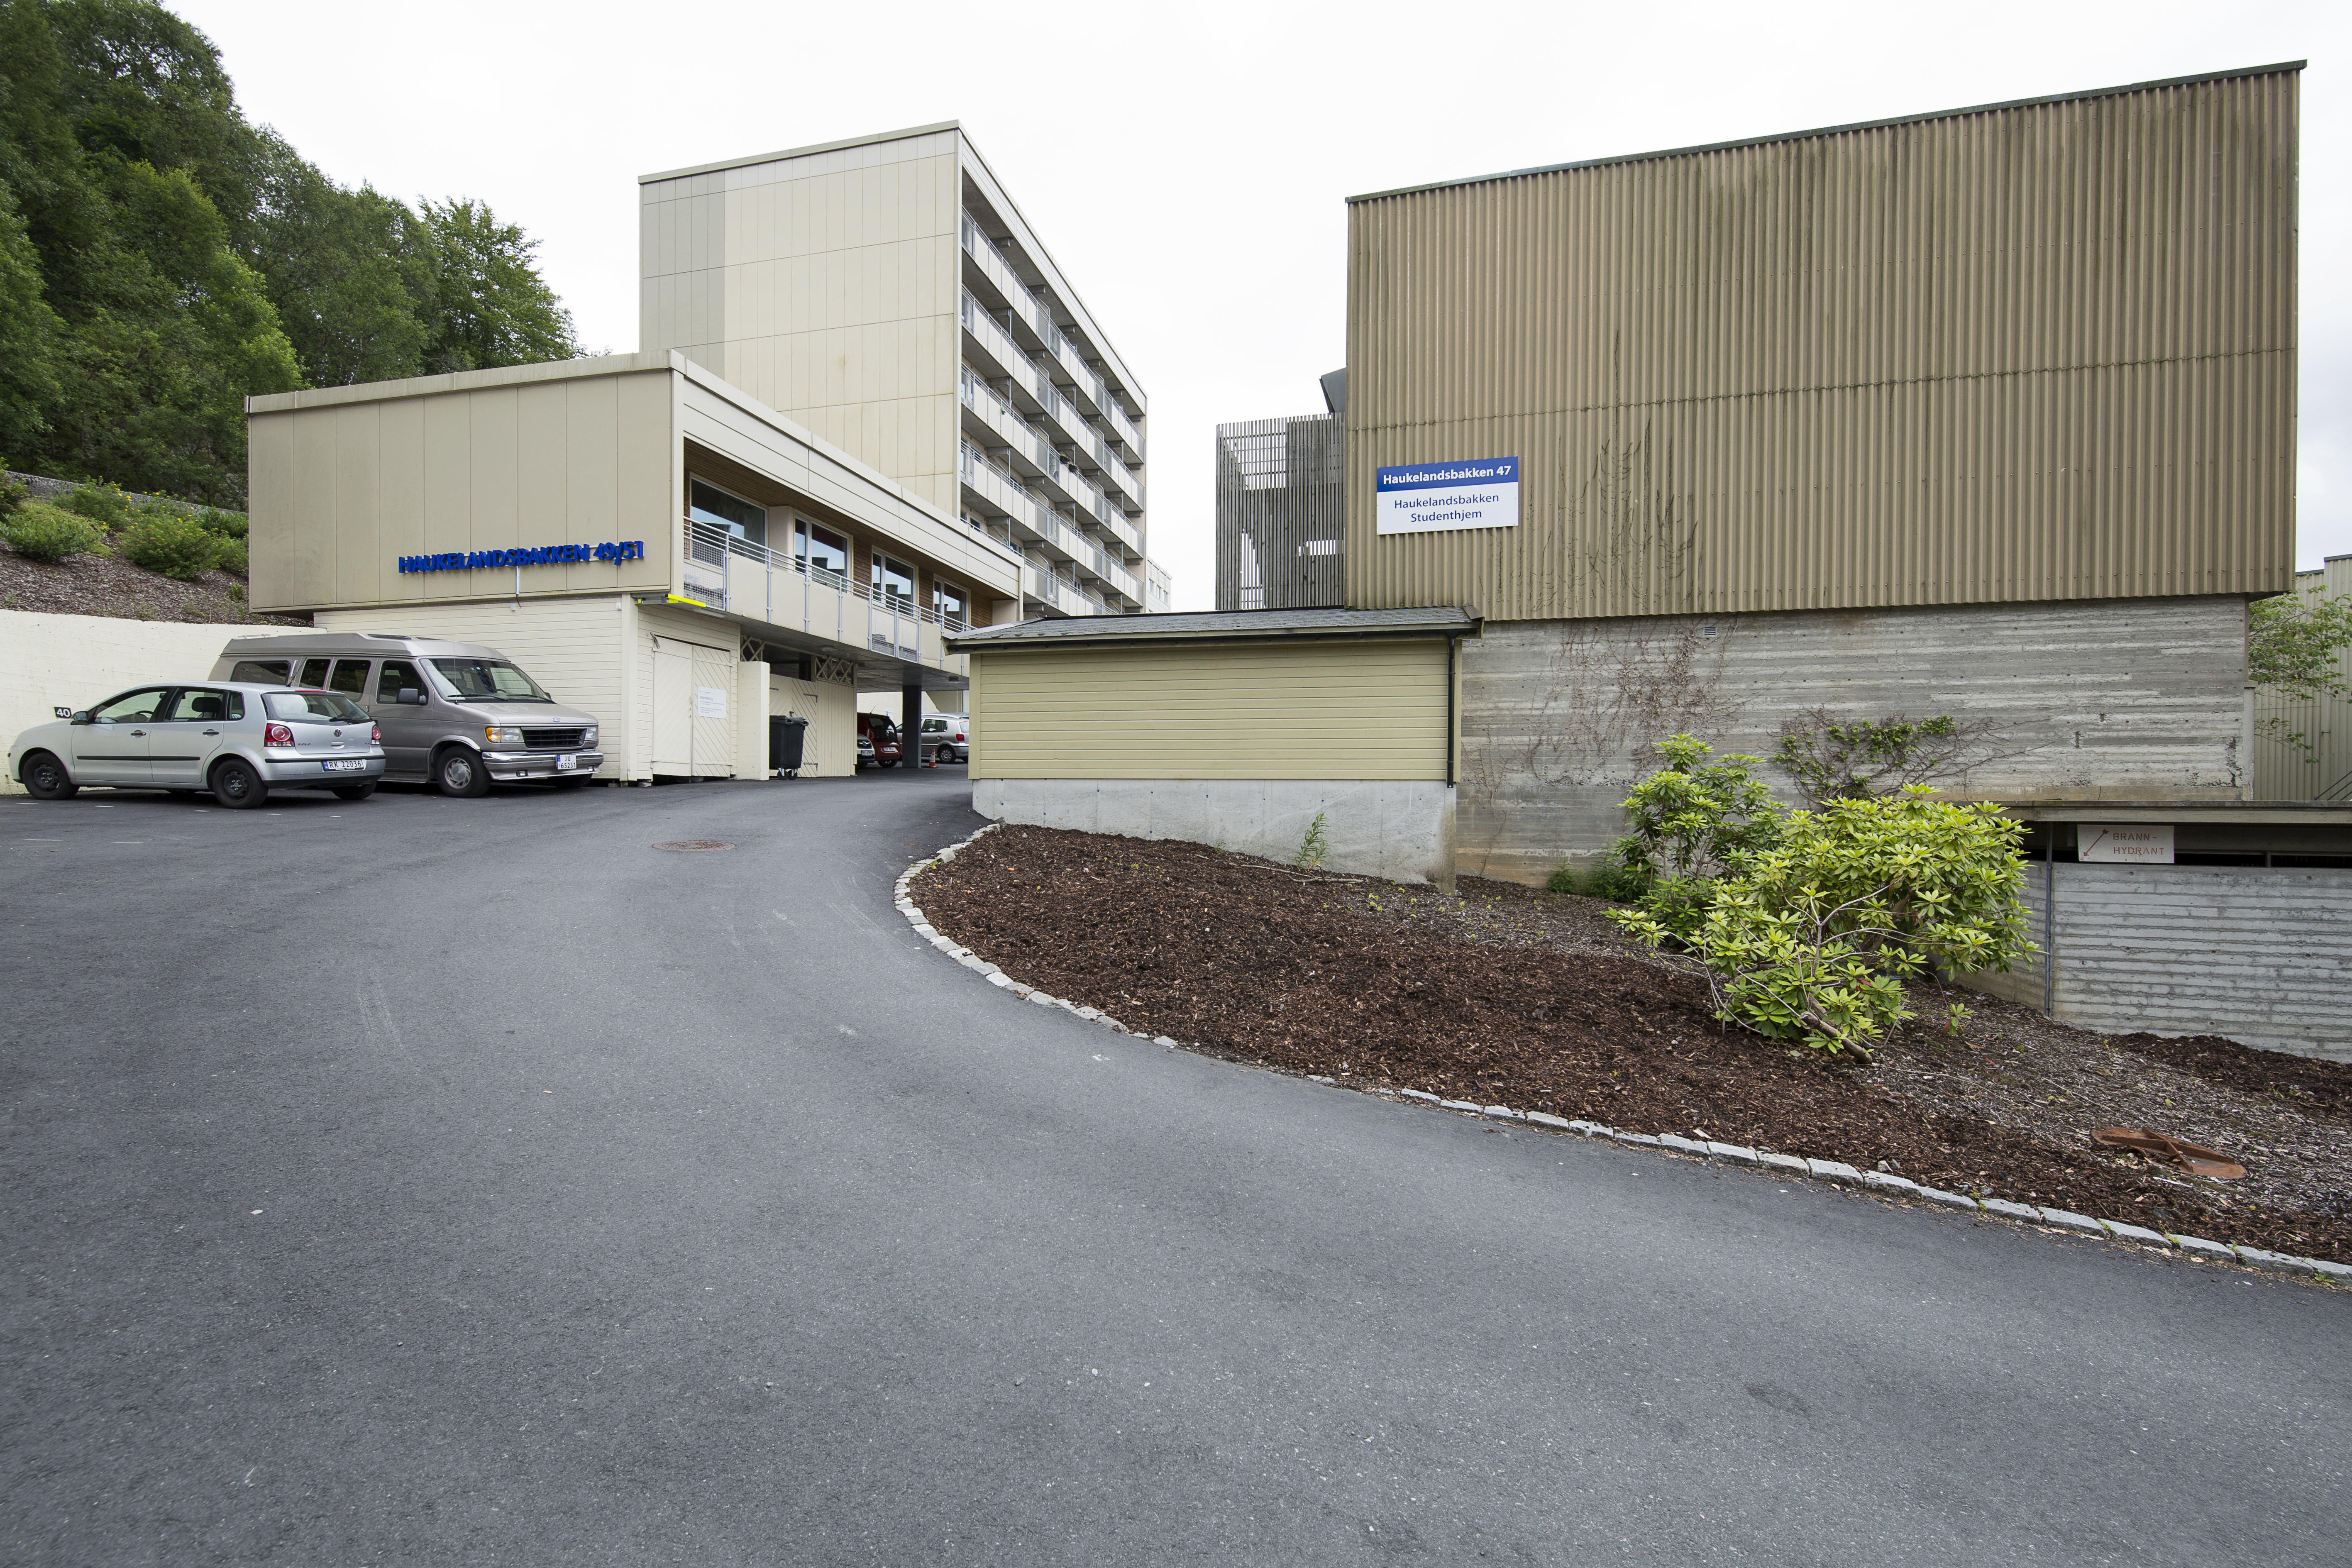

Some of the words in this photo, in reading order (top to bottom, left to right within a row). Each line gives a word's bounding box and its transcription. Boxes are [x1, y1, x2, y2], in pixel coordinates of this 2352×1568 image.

[1383, 468, 1494, 484] Haukelandsbakken
[1496, 465, 1511, 476] 47
[1395, 493, 1499, 509] Haukelandsbakken
[1411, 510, 1482, 522] Studenthjem
[398, 544, 589, 573] HAUKELANDSBAKKEN
[593, 540, 644, 566] 49/51
[56, 708, 70, 717] 40
[2113, 847, 2164, 855] HYDRANT
